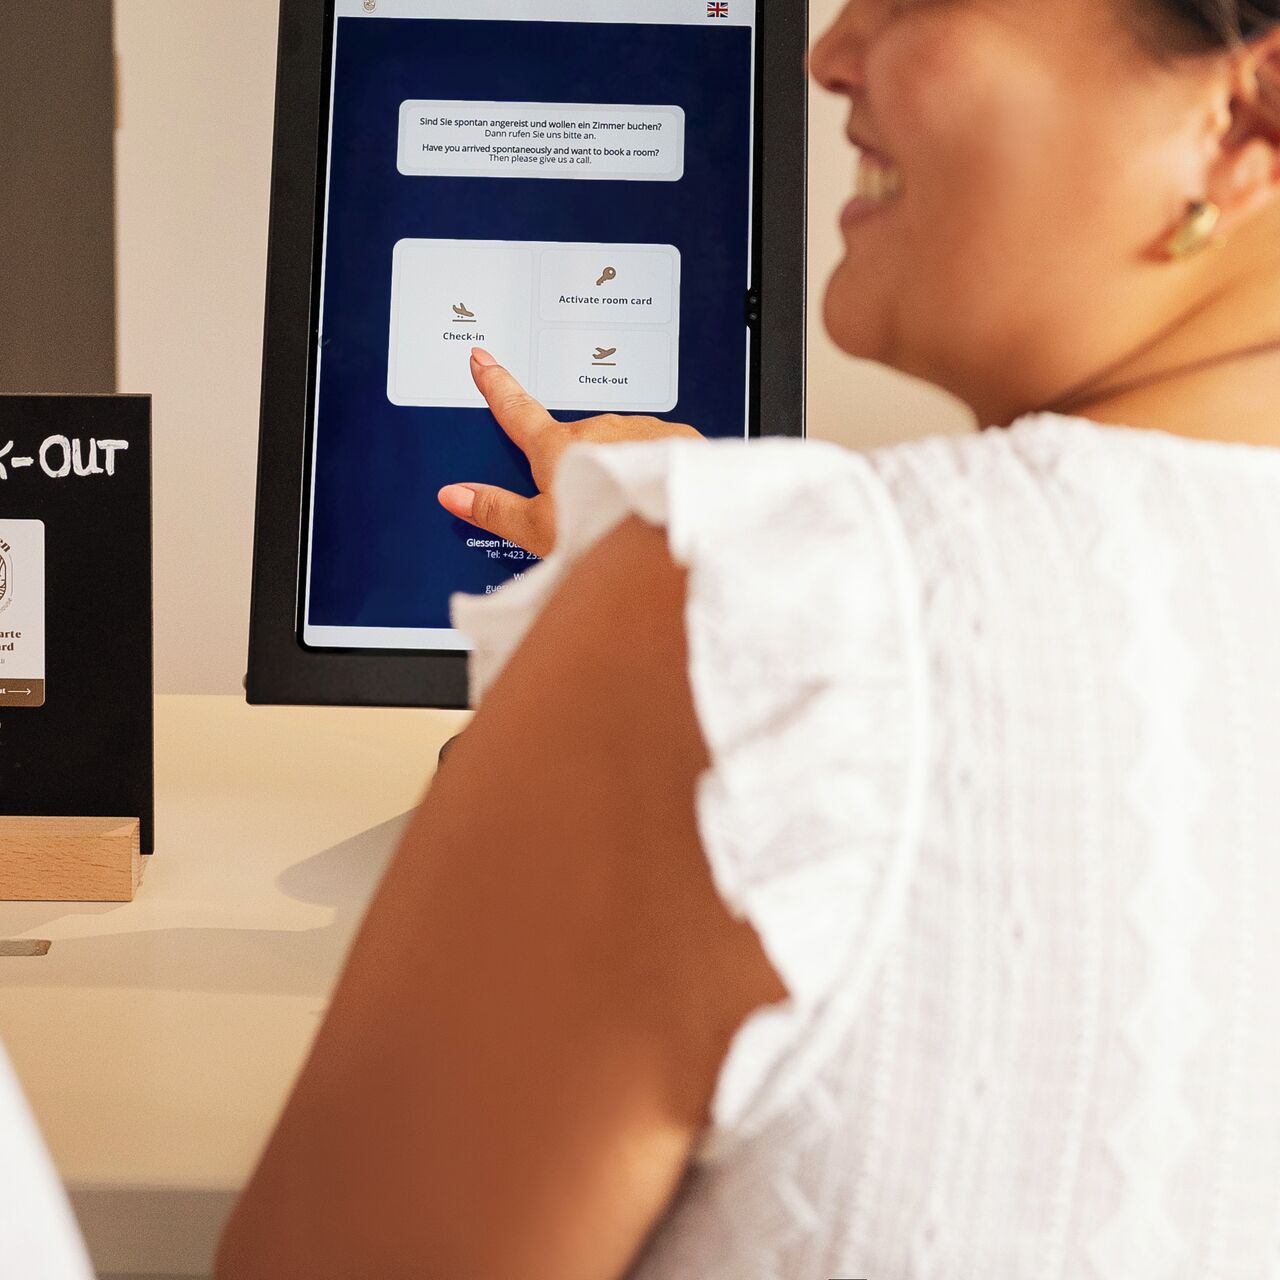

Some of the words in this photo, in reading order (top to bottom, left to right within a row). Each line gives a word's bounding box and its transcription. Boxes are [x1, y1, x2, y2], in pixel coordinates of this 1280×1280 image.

[420, 117, 438, 126] Sind
[440, 118, 453, 126] Sie
[454, 119, 488, 128] spontan
[490, 119, 528, 129] angereist
[530, 120, 547, 128] und
[549, 121, 576, 129] wollen
[578, 121, 591, 129] ein
[592, 122, 625, 130] Zimmer
[627, 122, 662, 131] buchen?
[485, 129, 507, 137] Dann
[508, 129, 530, 138] rufen
[533, 130, 545, 138] Sie
[563, 131, 582, 139] bitte
[422, 144, 443, 152] Have
[444, 145, 460, 154] you
[461, 145, 490, 153] arrived
[492, 146, 552, 156] spontaneously
[553, 147, 569, 155] and
[570, 147, 591, 155] want
[593, 147, 602, 155] to
[604, 147, 624, 156] book
[633, 148, 660, 157] room?
[489, 154, 509, 162] Then
[511, 154, 538, 164] please
[539, 156, 556, 165] give
[576, 156, 592, 164] call.
[558, 295, 600, 305] Activate
[602, 297, 628, 305] room
[630, 296, 652, 305] card
[442, 332, 485, 341] Check-in
[578, 375, 629, 385] Check-out
[466, 538, 500, 548] Giessen
[486, 550, 501, 559] Tel:
[502, 551, 524, 560] +423
